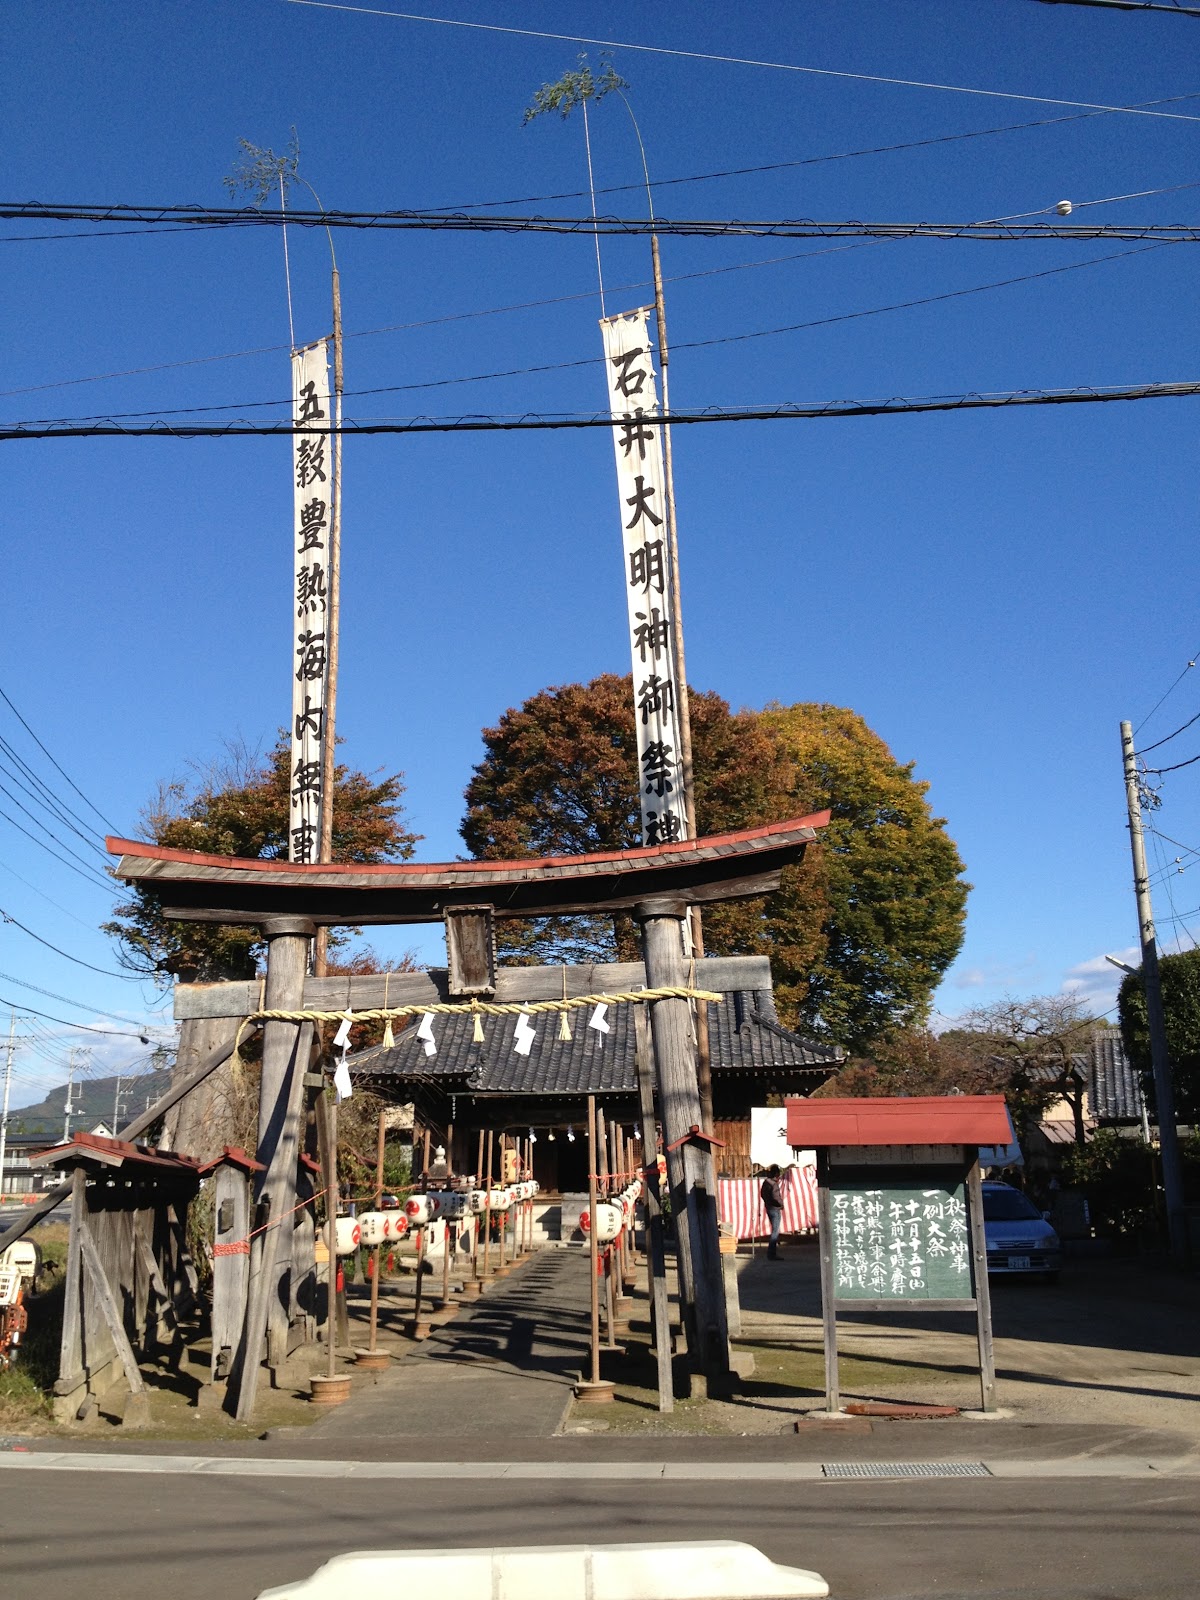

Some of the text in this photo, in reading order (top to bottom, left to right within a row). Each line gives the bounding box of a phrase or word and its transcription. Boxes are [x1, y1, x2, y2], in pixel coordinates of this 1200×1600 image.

[833, 1194, 856, 1289] 石井神社社務所
[944, 1196, 969, 1274] 秋祭り神事
